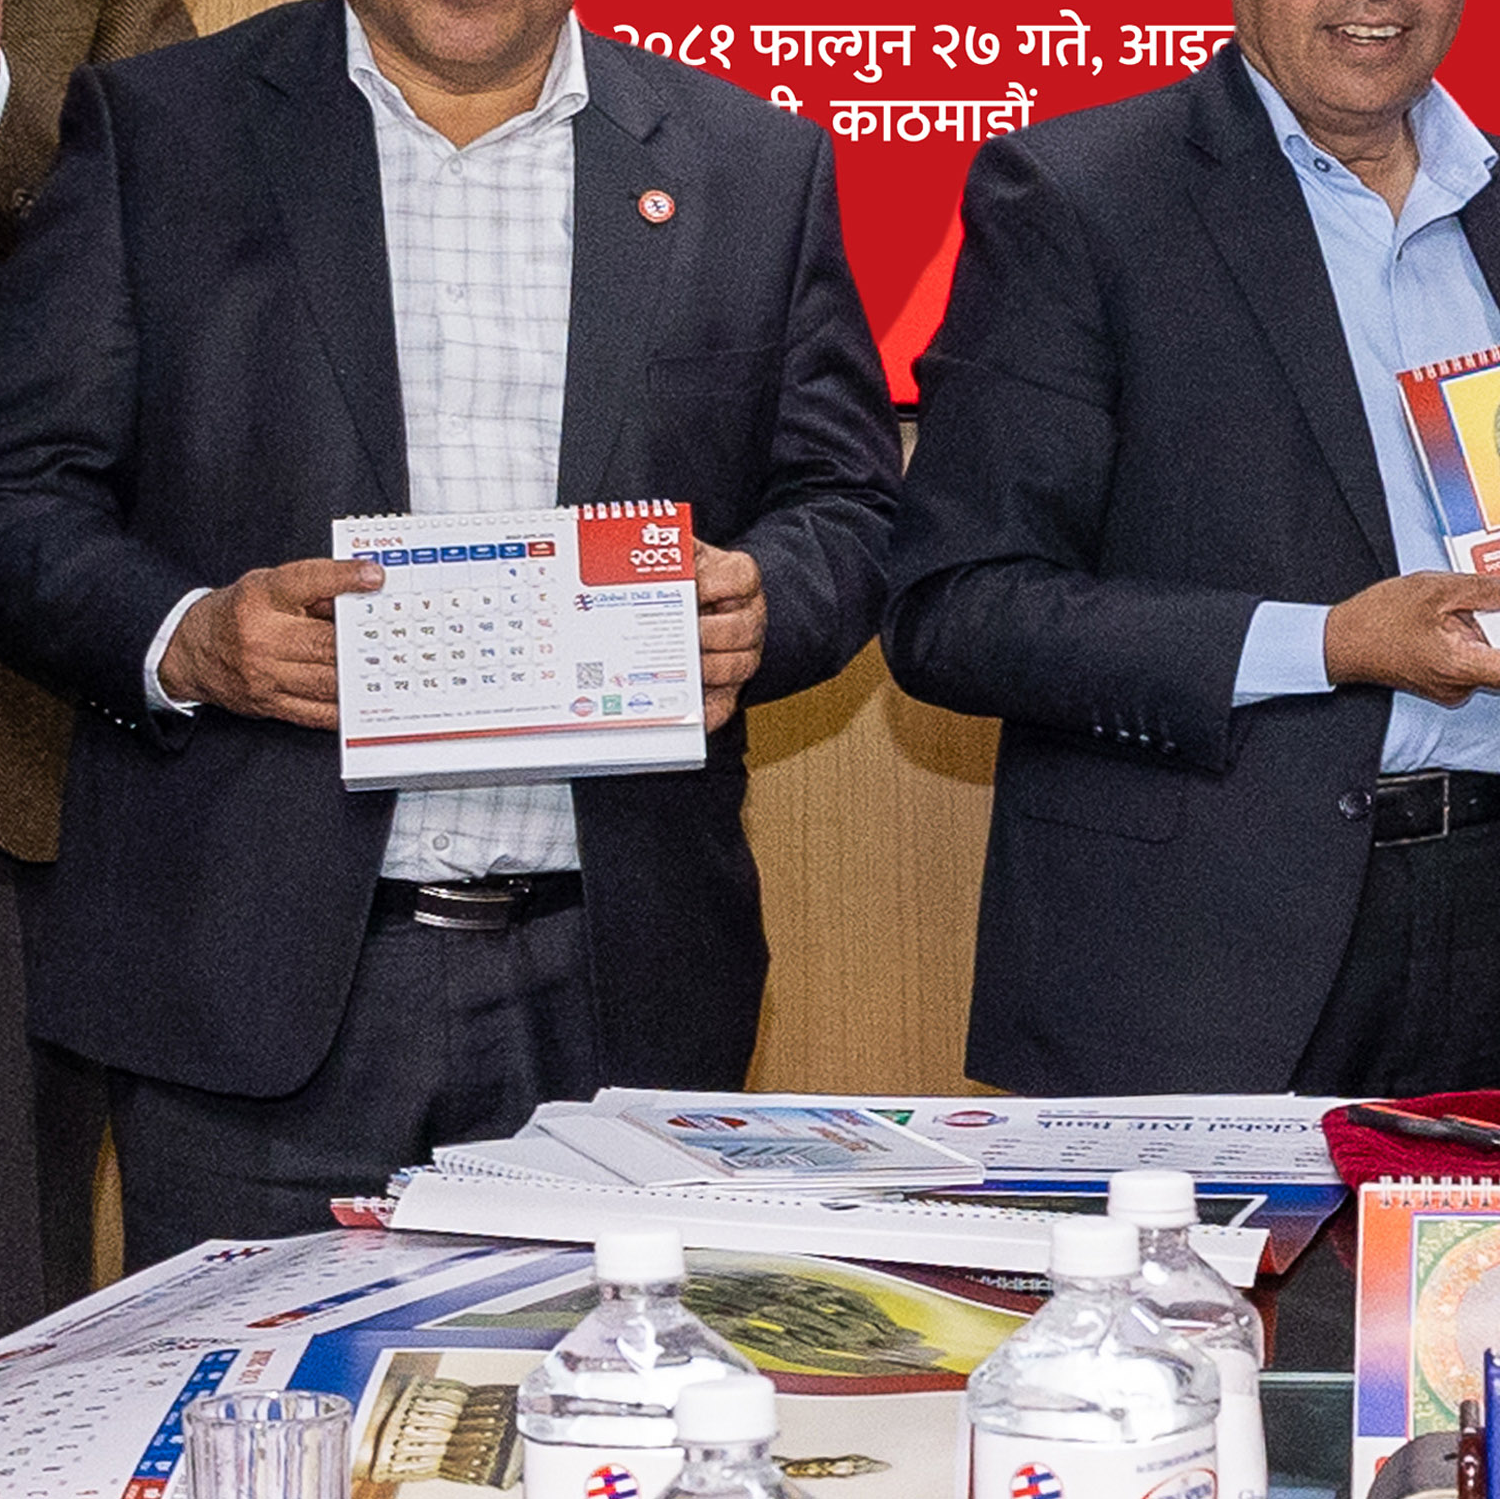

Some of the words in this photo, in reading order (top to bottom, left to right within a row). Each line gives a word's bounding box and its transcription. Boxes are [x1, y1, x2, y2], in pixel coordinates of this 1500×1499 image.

[750, 23, 916, 83] फाल्गुन
[931, 24, 1001, 71] २७
[1016, 9, 1103, 75] गते,
[630, 547, 682, 565] २०८१
